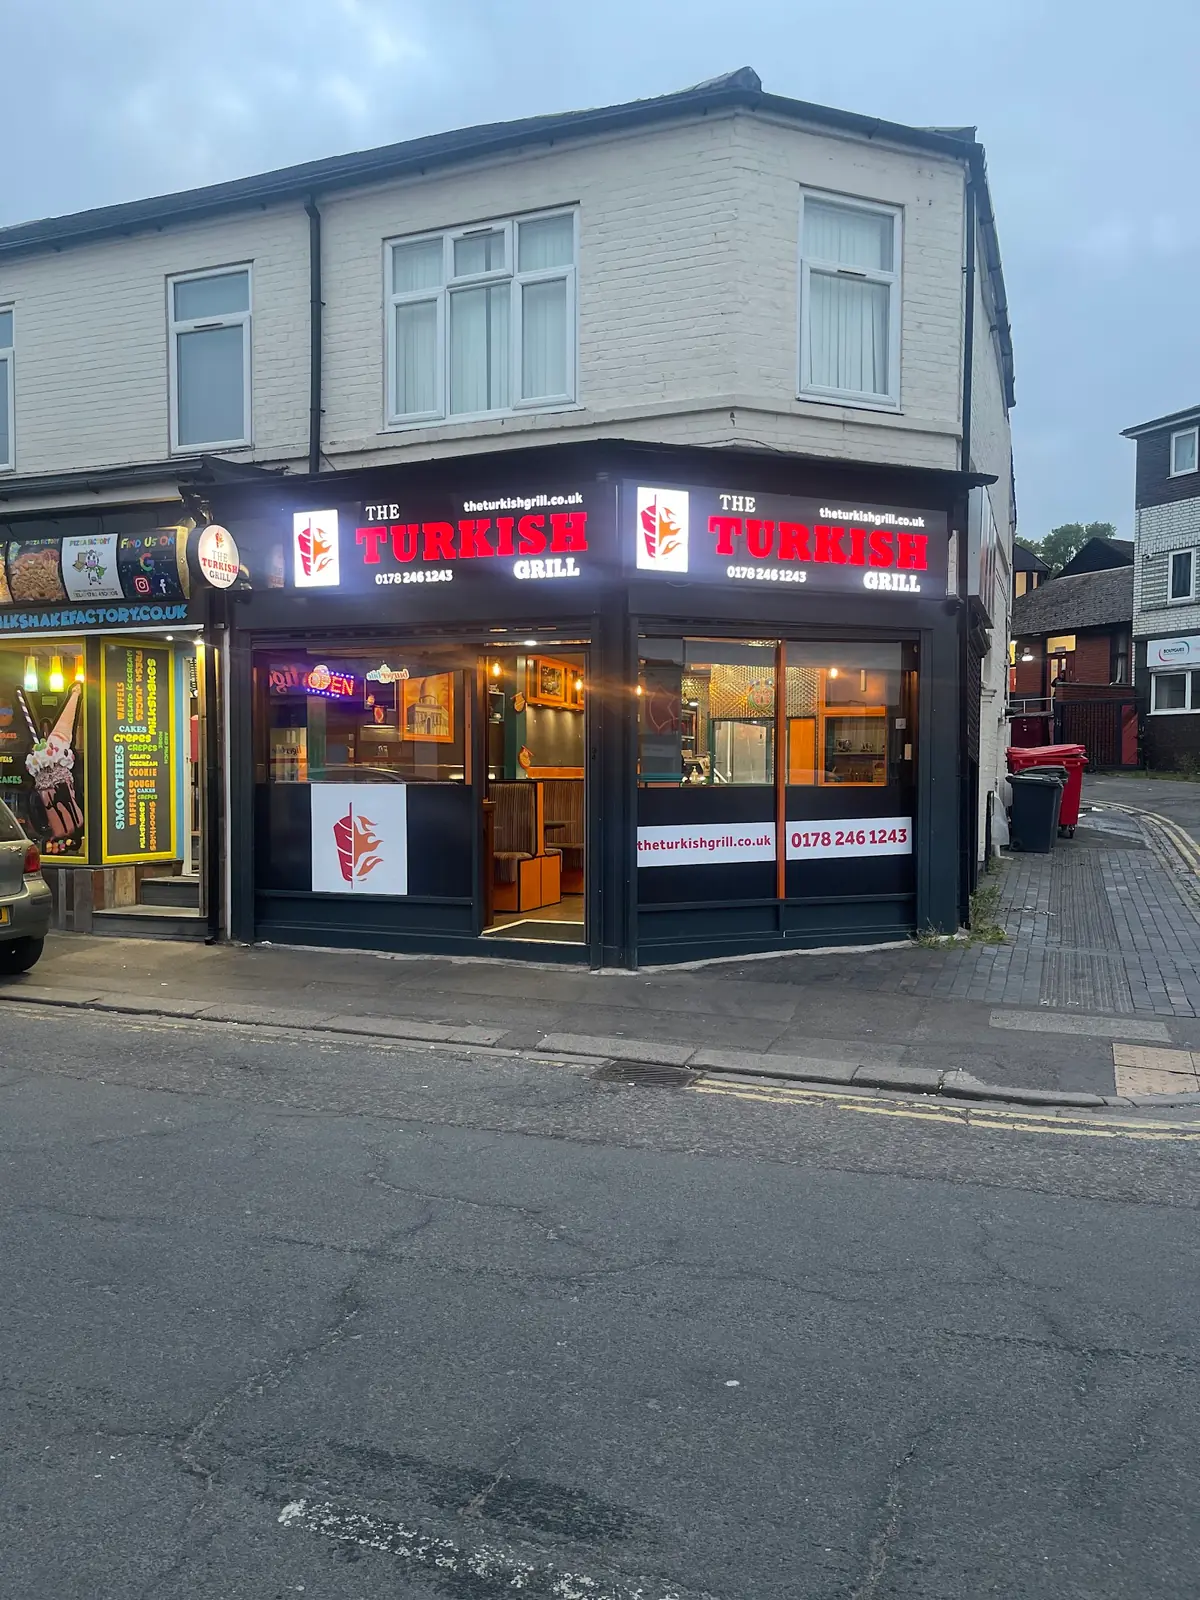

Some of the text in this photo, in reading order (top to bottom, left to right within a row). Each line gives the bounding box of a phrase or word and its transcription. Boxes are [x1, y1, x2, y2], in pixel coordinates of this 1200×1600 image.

[463, 492, 583, 513] theturkishgrill.co.uk
[719, 494, 756, 513] THE
[365, 503, 400, 521] THE
[819, 507, 925, 528] theturkishgrill.co.uk
[144, 536, 158, 548] US
[159, 535, 175, 546] ON
[355, 511, 589, 564] TURKISH
[708, 515, 928, 571] TURKISH
[211, 549, 229, 563] THE
[201, 557, 239, 575] TURKISH
[513, 557, 580, 580] GRILL
[727, 565, 807, 583] 0178 246 1243
[210, 570, 231, 583] GRILL
[374, 569, 453, 585] 0178 246 1243
[863, 571, 921, 593] GRILL
[308, 671, 354, 696] OPEN
[116, 682, 125, 720] WAFFELS
[119, 725, 147, 733] CAKES
[128, 768, 157, 777] COOKIE
[114, 744, 125, 830] SMOOTHIES
[128, 779, 155, 788] DOUGH
[637, 835, 771, 851] theturkishgrill.co.uk
[791, 828, 908, 848] 0178 246 1243
